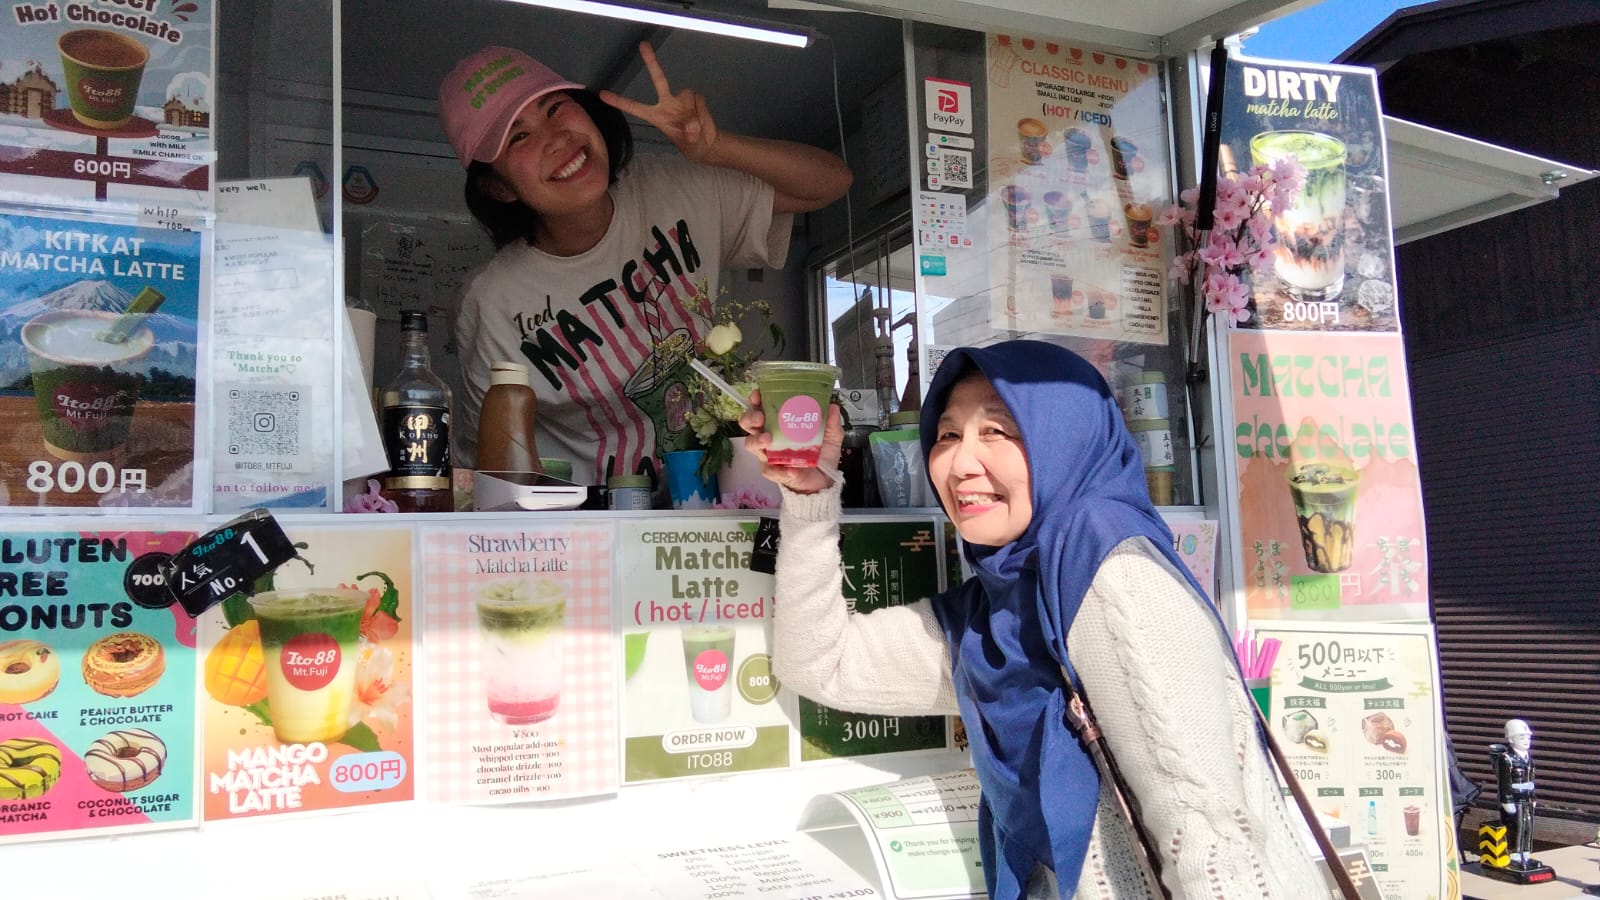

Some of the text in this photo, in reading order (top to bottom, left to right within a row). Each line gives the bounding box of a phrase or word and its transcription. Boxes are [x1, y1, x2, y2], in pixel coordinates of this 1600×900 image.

[15, 4, 58, 23] Hot
[66, 4, 181, 43] Chocolate
[1021, 60, 1085, 84] CLASSIC
[1088, 74, 1129, 93] MENU
[1243, 66, 1342, 103] DIRTY
[1035, 81, 1066, 93] UPGRADE
[1076, 89, 1096, 98] LARGE
[1037, 90, 1057, 99] SMALL
[933, 112, 965, 127] PayPay
[1246, 99, 1338, 120] matcha latte
[73, 159, 131, 179] 600円
[45, 230, 145, 257] KITKAT
[0, 250, 185, 281] MATCHA LATTE
[520, 219, 701, 391] MATCHA
[1283, 302, 1340, 324] 800円
[513, 294, 556, 341] Iced
[227, 350, 302, 363] Thank you so
[782, 411, 819, 423] Ito88
[407, 414, 429, 464] 甲州
[1235, 415, 1410, 459] chocolate
[26, 460, 147, 494] 800円
[234, 483, 247, 493] to
[251, 481, 290, 493] follow
[192, 528, 235, 558] Ito88
[468, 532, 569, 555] Strawberry
[641, 531, 757, 544] CEREMONIAL GRA
[209, 530, 270, 597] No. 1
[476, 556, 568, 574] Matcha Latte
[655, 545, 753, 571] Matcha
[132, 574, 168, 586] 700
[181, 562, 214, 591] 人気
[671, 574, 740, 599] Latte
[861, 558, 881, 605] 抹茶
[650, 600, 693, 622] hot
[715, 597, 765, 620] iced
[286, 649, 337, 666] Ito88
[1297, 640, 1385, 671] 500円以下
[293, 667, 328, 678] Mt.Fuji
[749, 675, 770, 687] 800
[1322, 666, 1367, 679] メニュー
[26, 710, 59, 721] CAKE
[80, 704, 174, 717] PEANUT BUTTER
[80, 713, 162, 727] & CHOCOLATE
[671, 730, 746, 746] ORDER NOW
[842, 716, 900, 743] 300円
[227, 741, 329, 771] MANGO
[472, 739, 558, 754] Most popular add-ons
[476, 760, 542, 775] chocolate drizzle
[479, 751, 540, 764] whipped cream
[687, 751, 733, 770] ITO88
[210, 763, 321, 795] MATCHA
[334, 758, 401, 784] 800円
[476, 772, 542, 785] caramel drizzle
[1375, 769, 1402, 781] 300円
[229, 785, 303, 814] LATTE
[489, 784, 530, 796] cacao nibs
[0, 801, 51, 813] RGANIC
[77, 793, 179, 810] COCONUT SUGAR
[88, 803, 171, 818] & CHOCOLATE
[656, 838, 792, 859] SWEETNESS LEVEL
